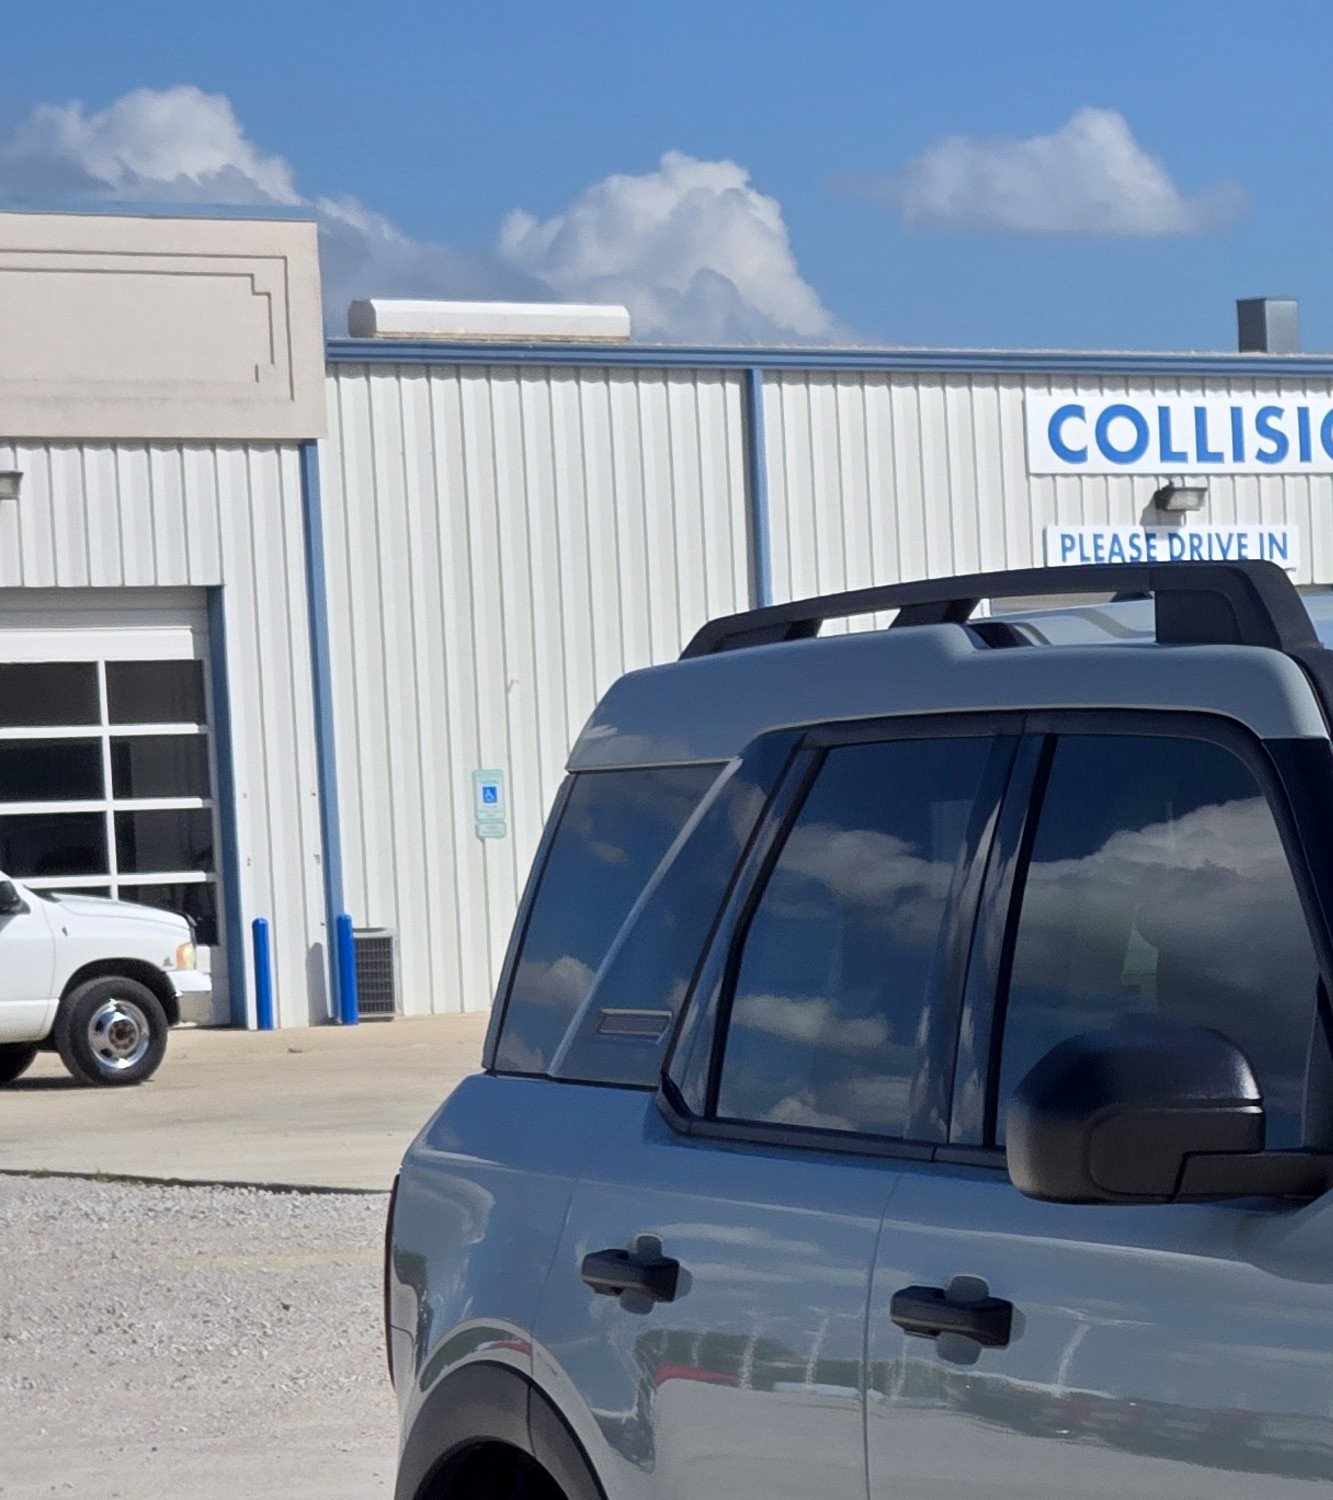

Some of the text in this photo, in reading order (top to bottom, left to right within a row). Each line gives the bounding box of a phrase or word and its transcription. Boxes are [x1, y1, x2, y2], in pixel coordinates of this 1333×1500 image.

[1060, 532, 1289, 562] PLEASE DRIVE IN
